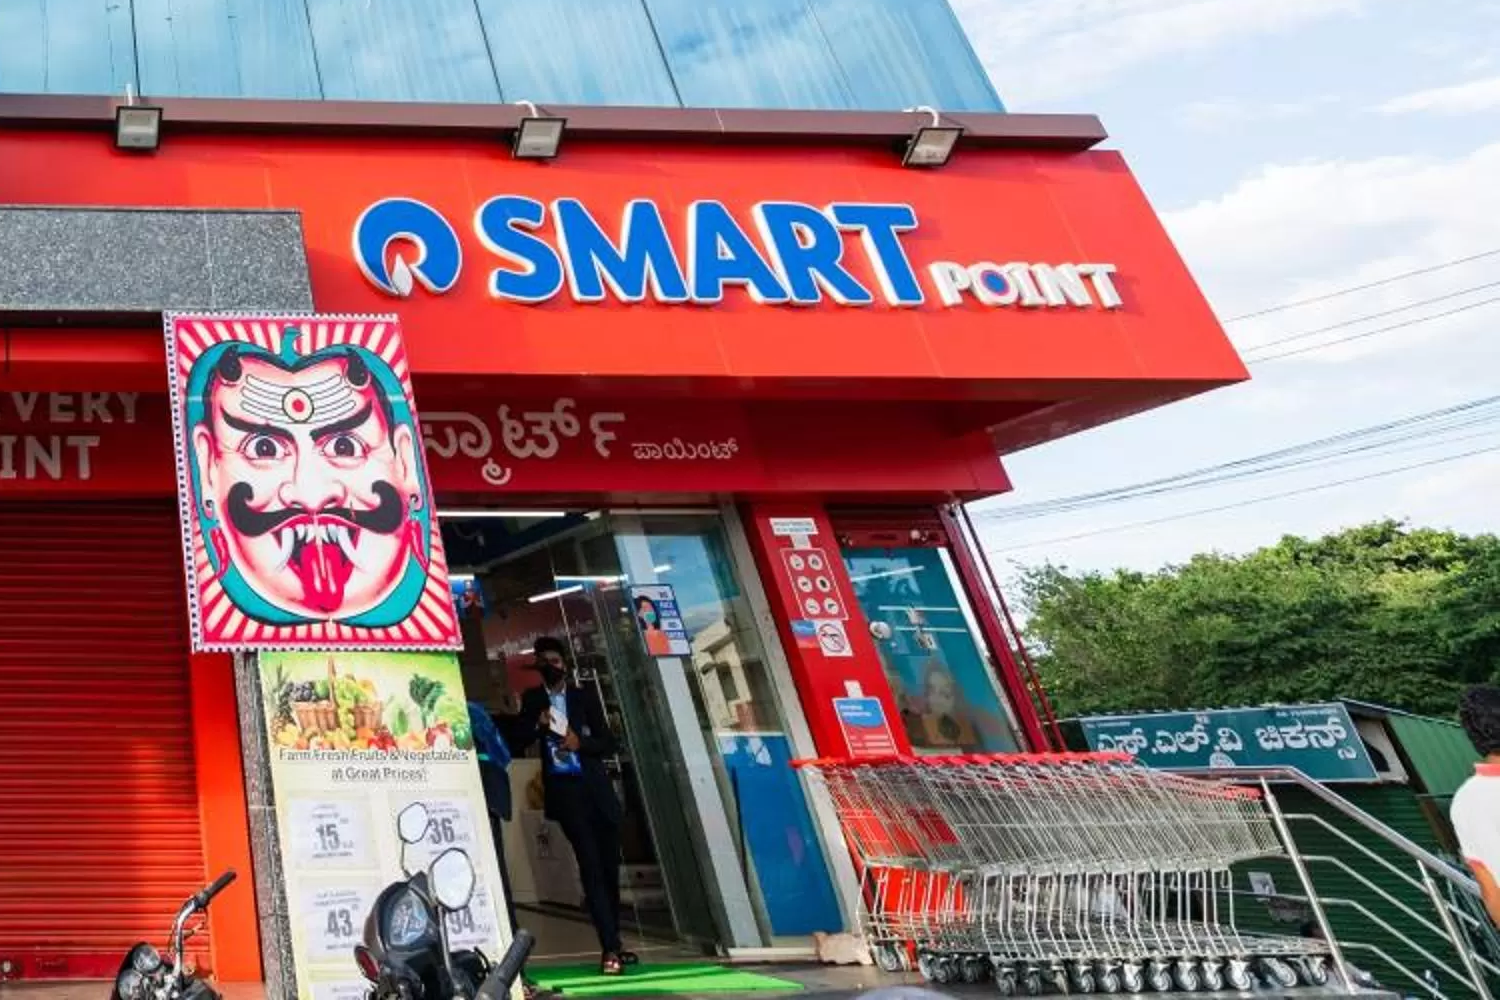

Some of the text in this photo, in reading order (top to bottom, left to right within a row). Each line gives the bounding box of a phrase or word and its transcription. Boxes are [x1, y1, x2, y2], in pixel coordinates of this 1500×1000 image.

[476, 194, 1124, 309] SMART POINT
[400, 750, 469, 764] Vegetables
[345, 767, 381, 781] Great
[315, 824, 340, 851] 15
[428, 817, 456, 845] 36
[326, 907, 353, 938] 43
